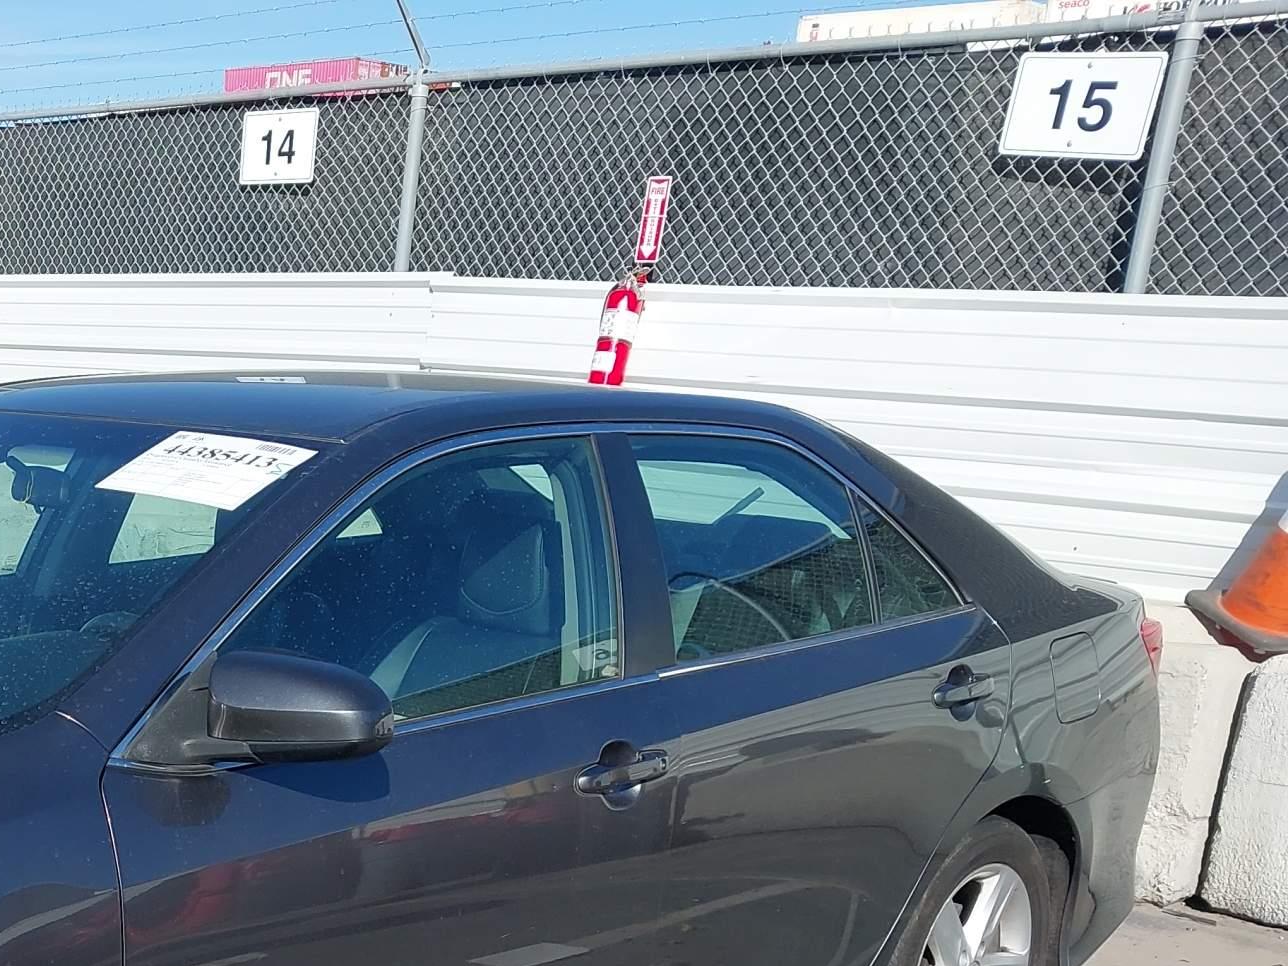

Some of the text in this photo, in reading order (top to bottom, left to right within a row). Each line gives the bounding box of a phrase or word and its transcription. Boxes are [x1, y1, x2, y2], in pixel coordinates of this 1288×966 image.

[1049, 79, 1118, 132] 15
[261, 129, 296, 165] 14
[163, 443, 279, 468] 44385413
